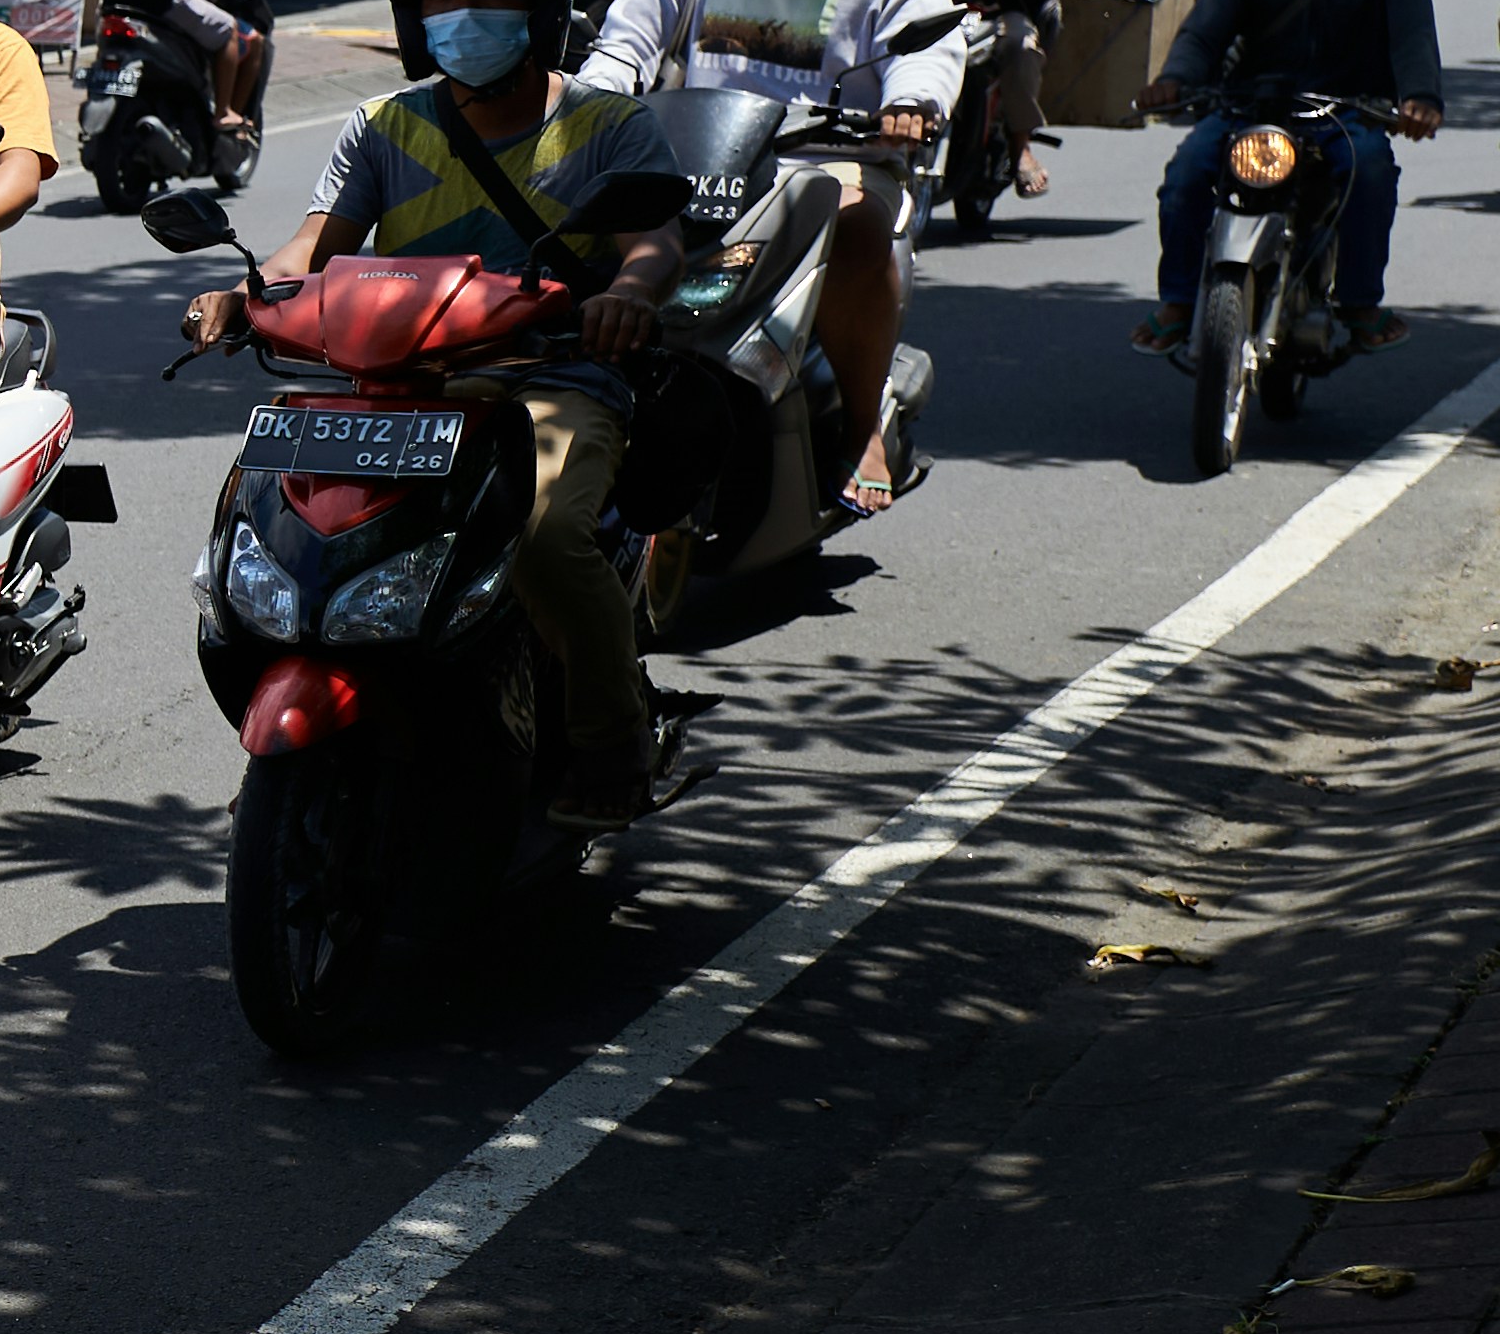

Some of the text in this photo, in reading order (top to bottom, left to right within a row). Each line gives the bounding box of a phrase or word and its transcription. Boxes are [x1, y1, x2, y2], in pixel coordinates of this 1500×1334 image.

[358, 270, 420, 281] HONDA
[252, 412, 458, 444] DK 5372 IM
